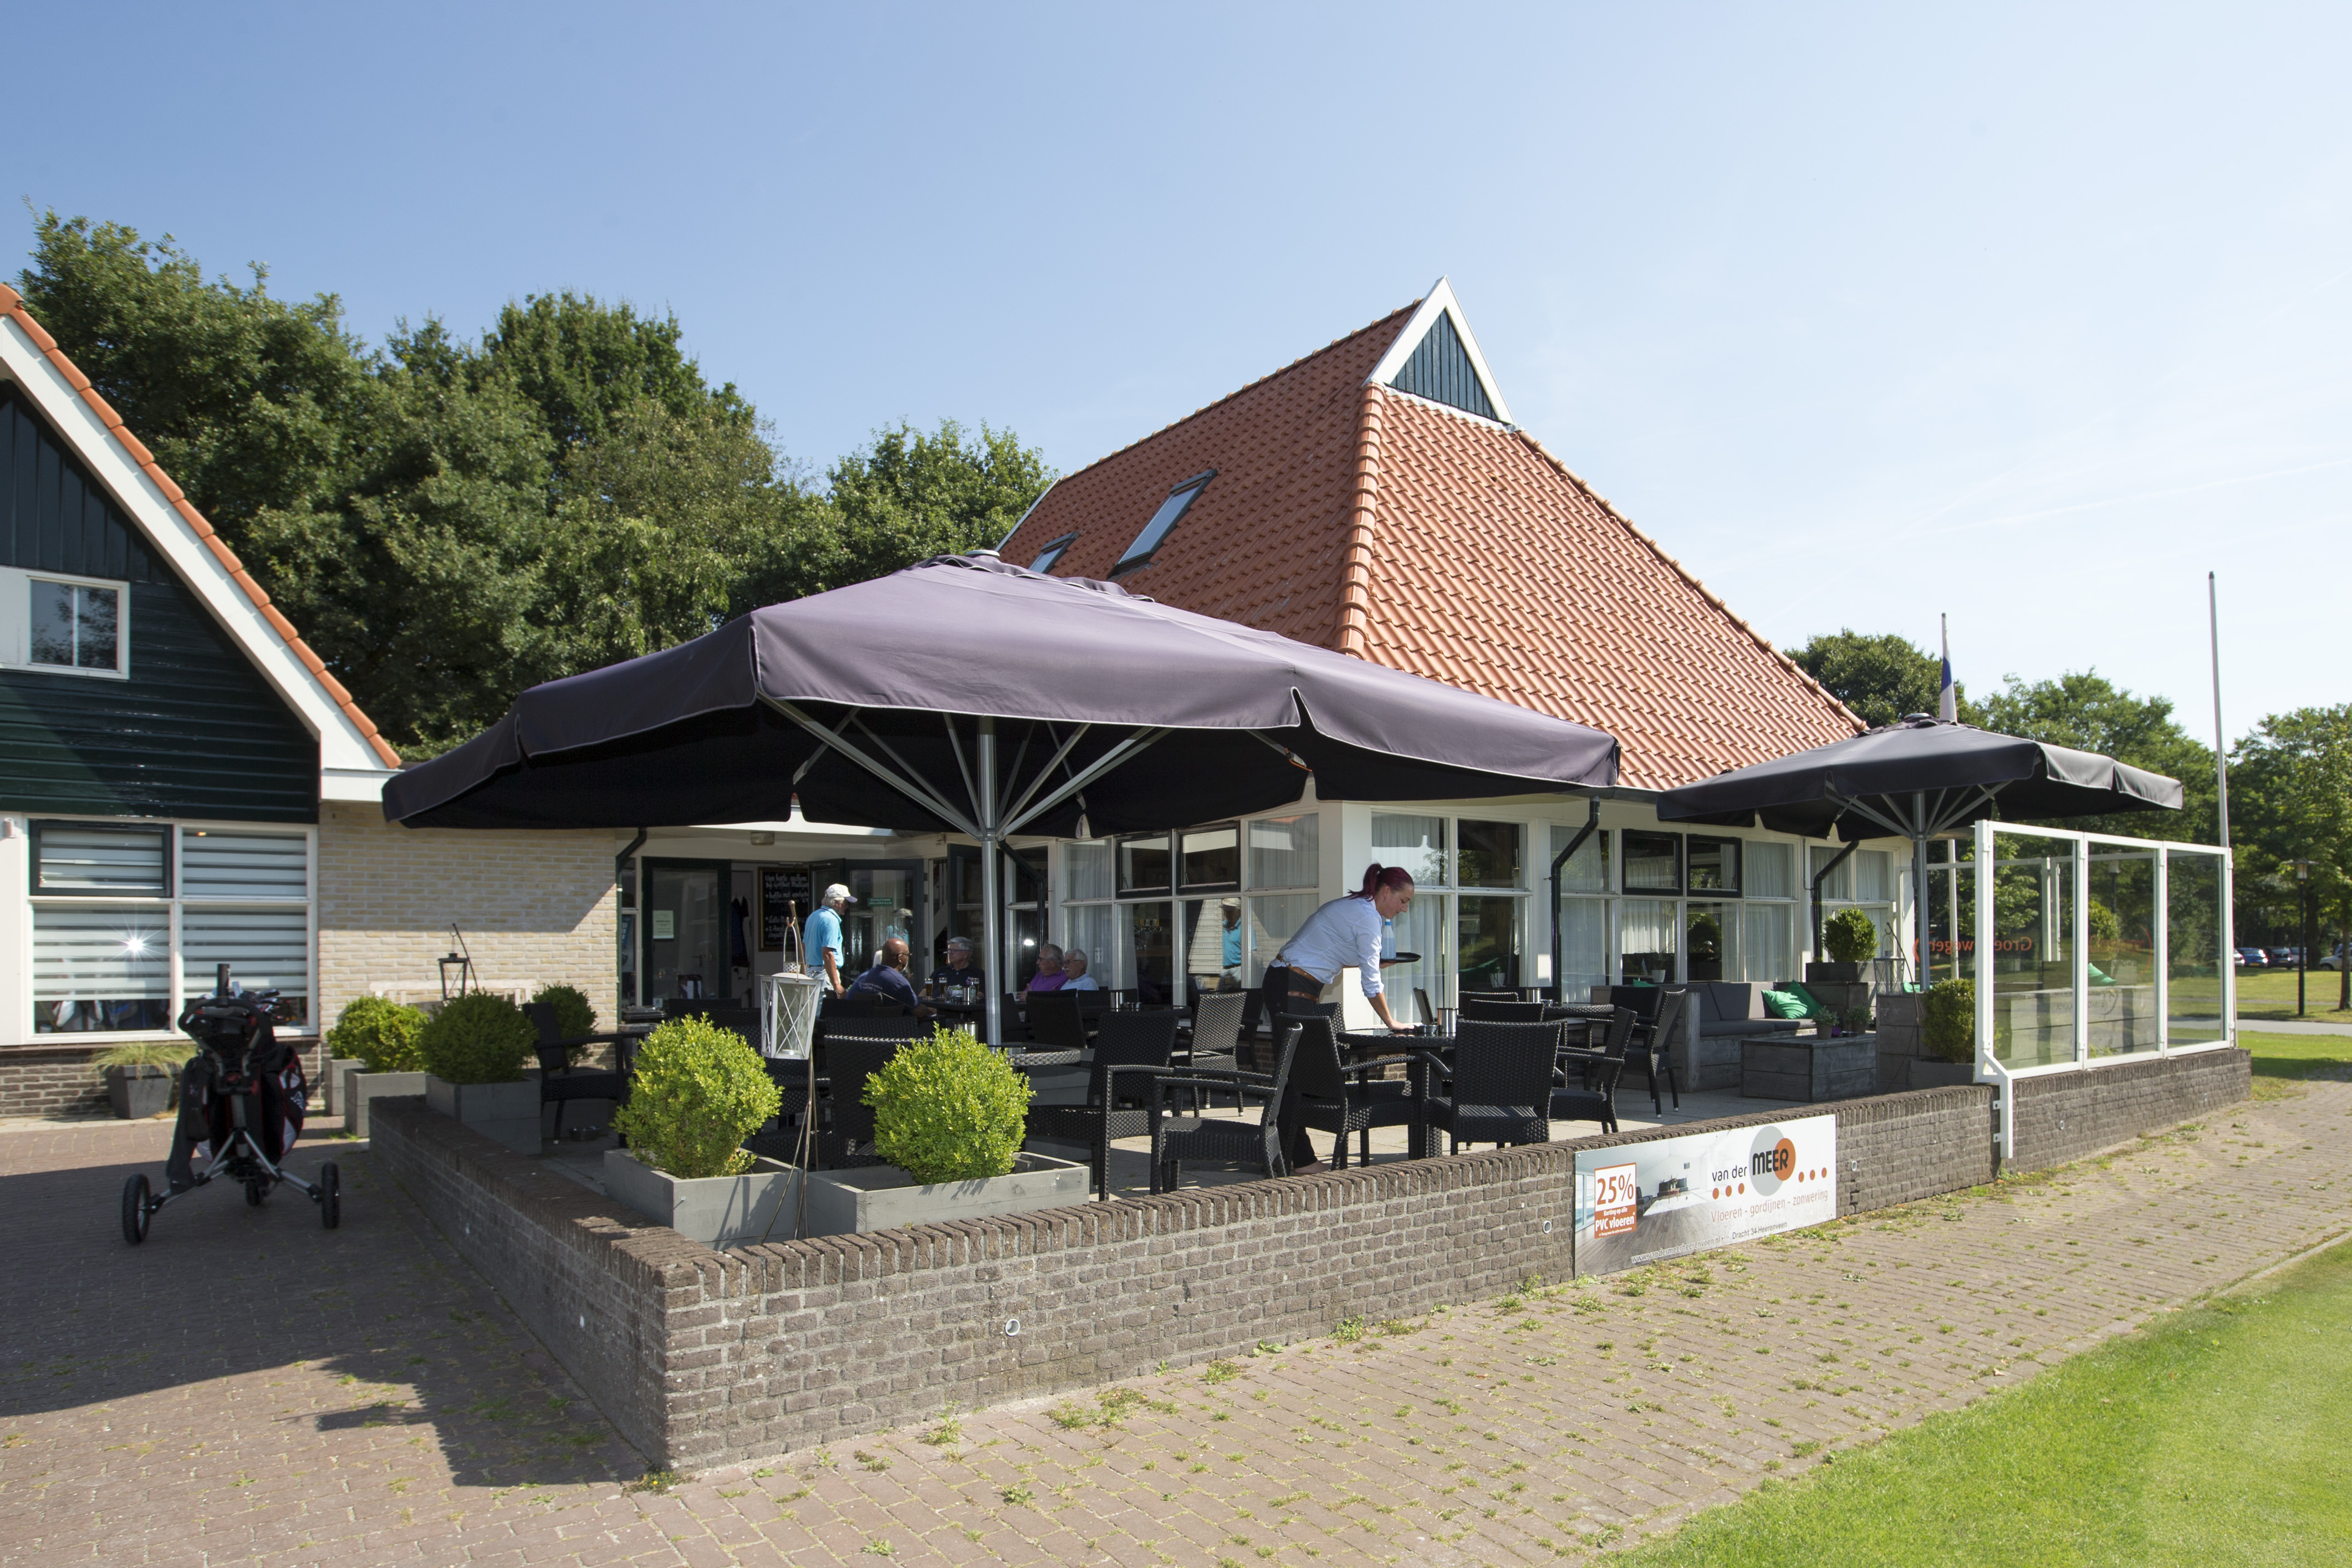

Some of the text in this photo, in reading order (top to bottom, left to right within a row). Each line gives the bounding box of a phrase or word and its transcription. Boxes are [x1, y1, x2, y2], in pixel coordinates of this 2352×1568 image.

[1712, 1148, 1789, 1182] van der MEER
[1596, 1173, 1634, 1205] 25%
[1711, 1208, 1742, 1223] Vloeren
[1750, 1198, 1785, 1217] gordijnen
[1793, 1189, 1828, 1206] zonwering
[1595, 1218, 1608, 1232] PVC
[1732, 1222, 1787, 1239] Dracht 34 Heerenveen
[1631, 1236, 1721, 1264] www.vandermeerheerenveen.nl
